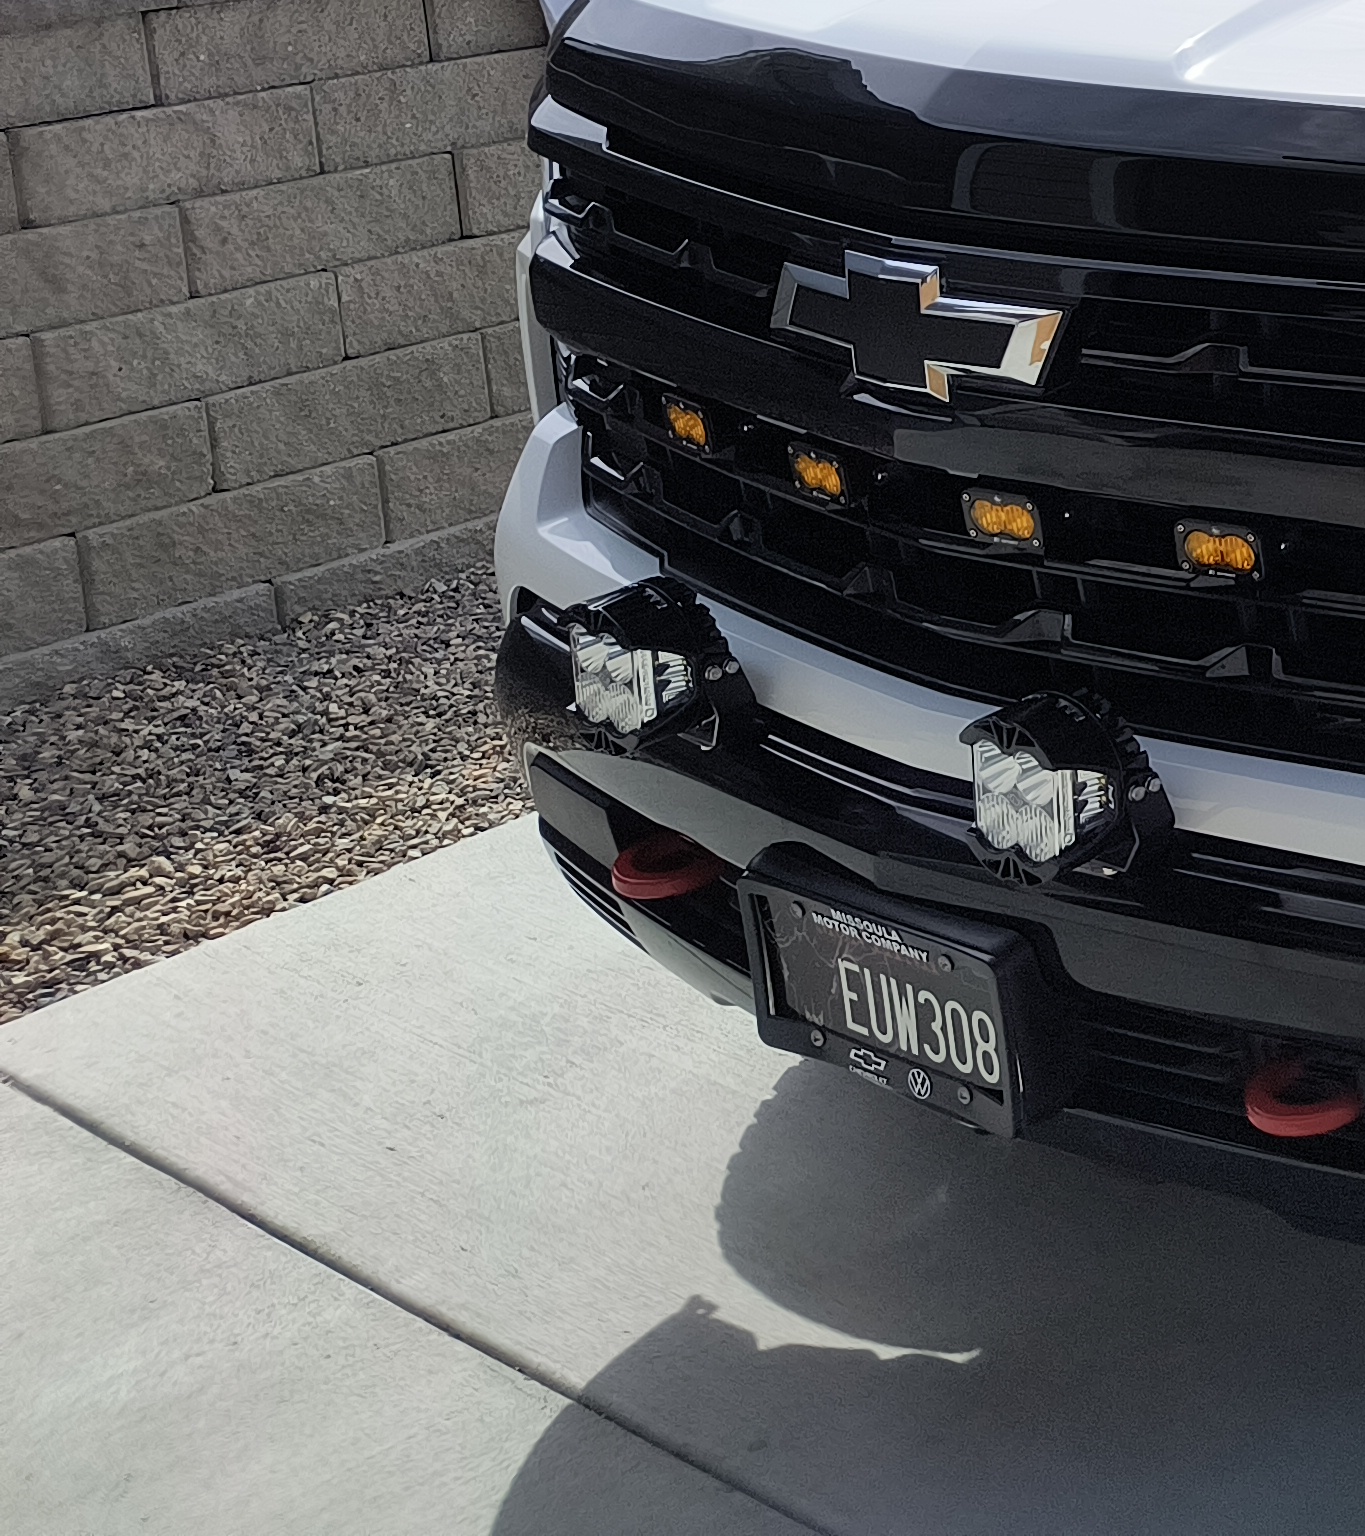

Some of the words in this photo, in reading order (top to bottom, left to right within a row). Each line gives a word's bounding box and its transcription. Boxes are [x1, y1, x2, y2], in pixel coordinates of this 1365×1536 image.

[812, 912, 861, 940] MOTOR
[861, 929, 929, 963] COMPANY
[830, 908, 903, 943] MISSOULA
[838, 958, 1001, 1084] EUW308
